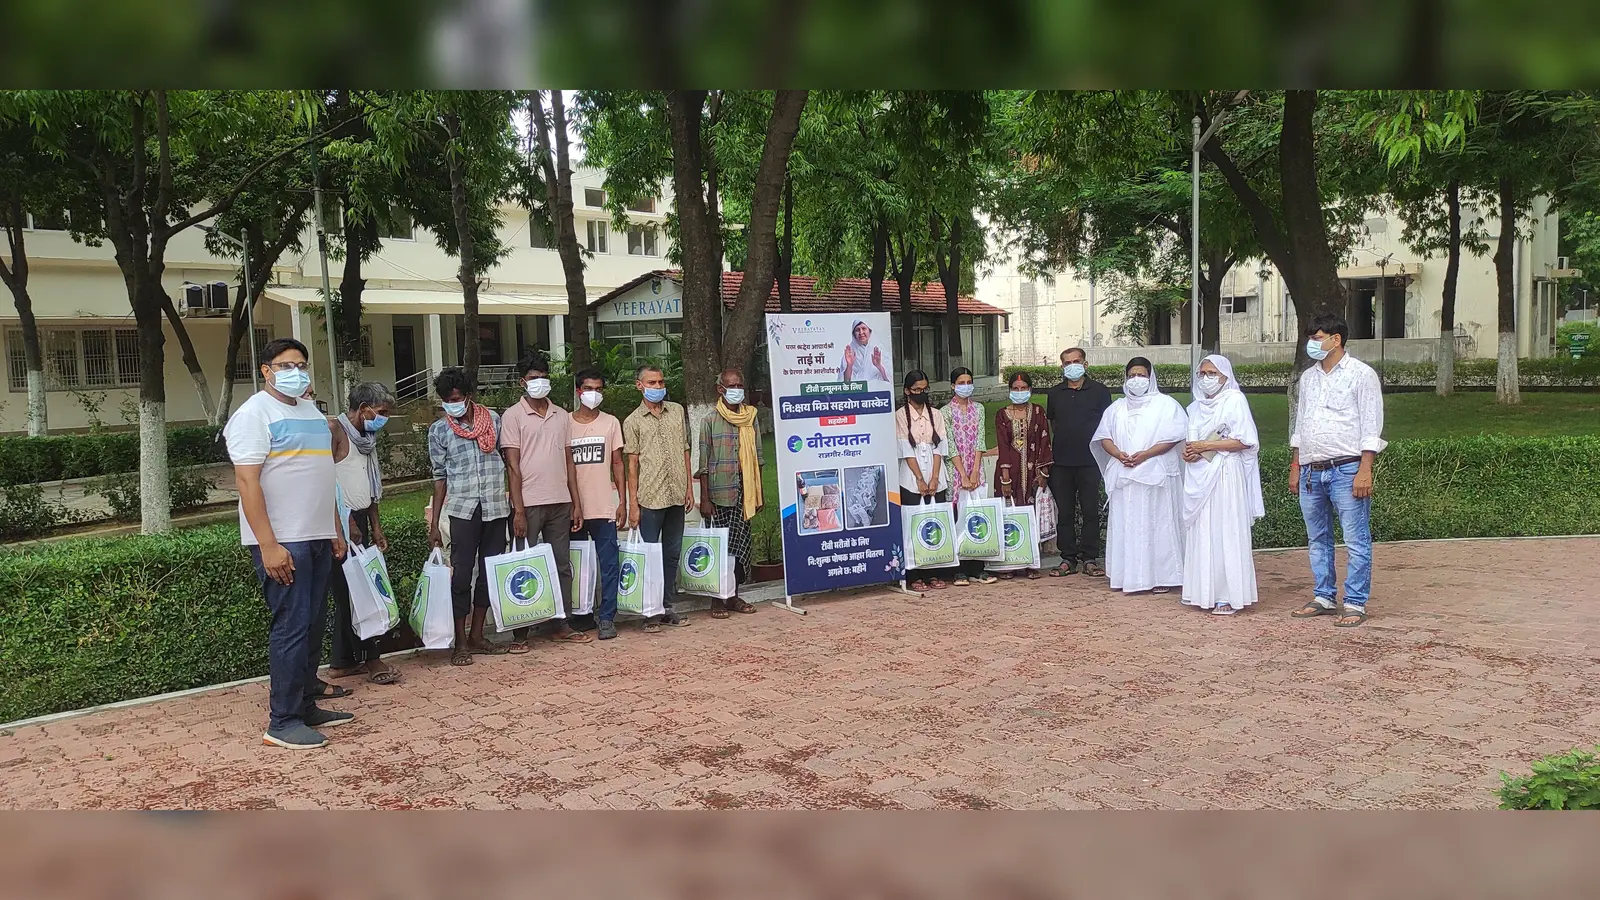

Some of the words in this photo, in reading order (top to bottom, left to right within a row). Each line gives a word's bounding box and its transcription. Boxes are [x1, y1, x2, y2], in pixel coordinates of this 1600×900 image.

[614, 299, 683, 316] VEERAYAT
[797, 353, 813, 366] ताई
[814, 352, 825, 364] माँ
[820, 384, 842, 394] उन्मूलन
[842, 383, 849, 391] के
[850, 382, 863, 390] लिए
[812, 400, 829, 412] मित्र
[830, 398, 860, 411] सहयोग
[861, 397, 889, 408] बास्केट
[828, 416, 848, 425] सहयोगी
[806, 432, 871, 449] वीरायतन
[571, 445, 602, 463] RUE
[851, 537, 857, 547] के
[858, 536, 870, 546] लिए
[832, 553, 849, 563] पोषक
[849, 552, 865, 561] आहार
[866, 549, 885, 559] वितरण
[828, 566, 843, 577] अगले
[507, 606, 552, 622] VEERAYATAN
